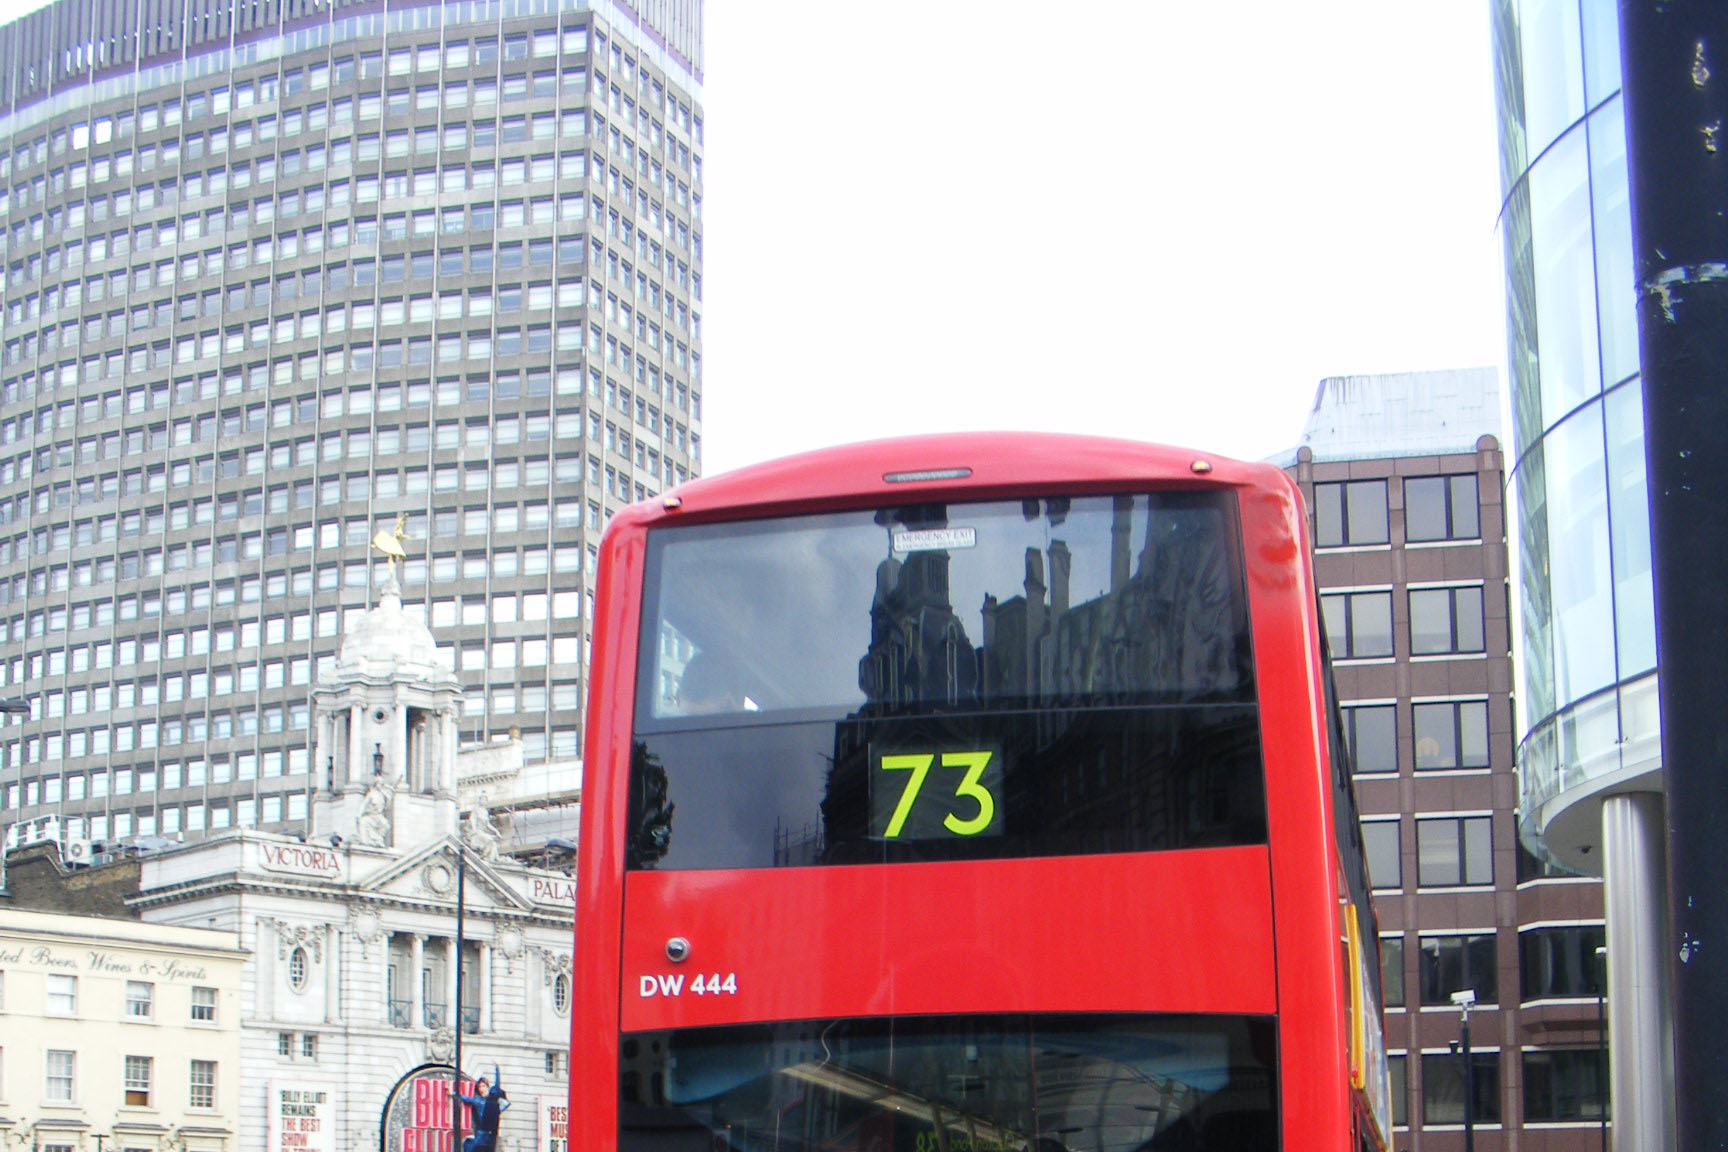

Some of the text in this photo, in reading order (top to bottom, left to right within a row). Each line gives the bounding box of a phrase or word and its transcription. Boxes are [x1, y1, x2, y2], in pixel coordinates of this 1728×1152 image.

[881, 751, 995, 837] 73
[263, 844, 340, 871] VICTORIA
[534, 879, 577, 901] PALA
[30, 945, 78, 968] Beers
[88, 950, 132, 973] Wines
[158, 957, 207, 980] Spirits
[640, 972, 738, 998] DW 444
[281, 1104, 316, 1117] REMAINS
[413, 1077, 476, 1130] BILY
[281, 1117, 321, 1132] THE BEST
[281, 1132, 308, 1147] SHOW
